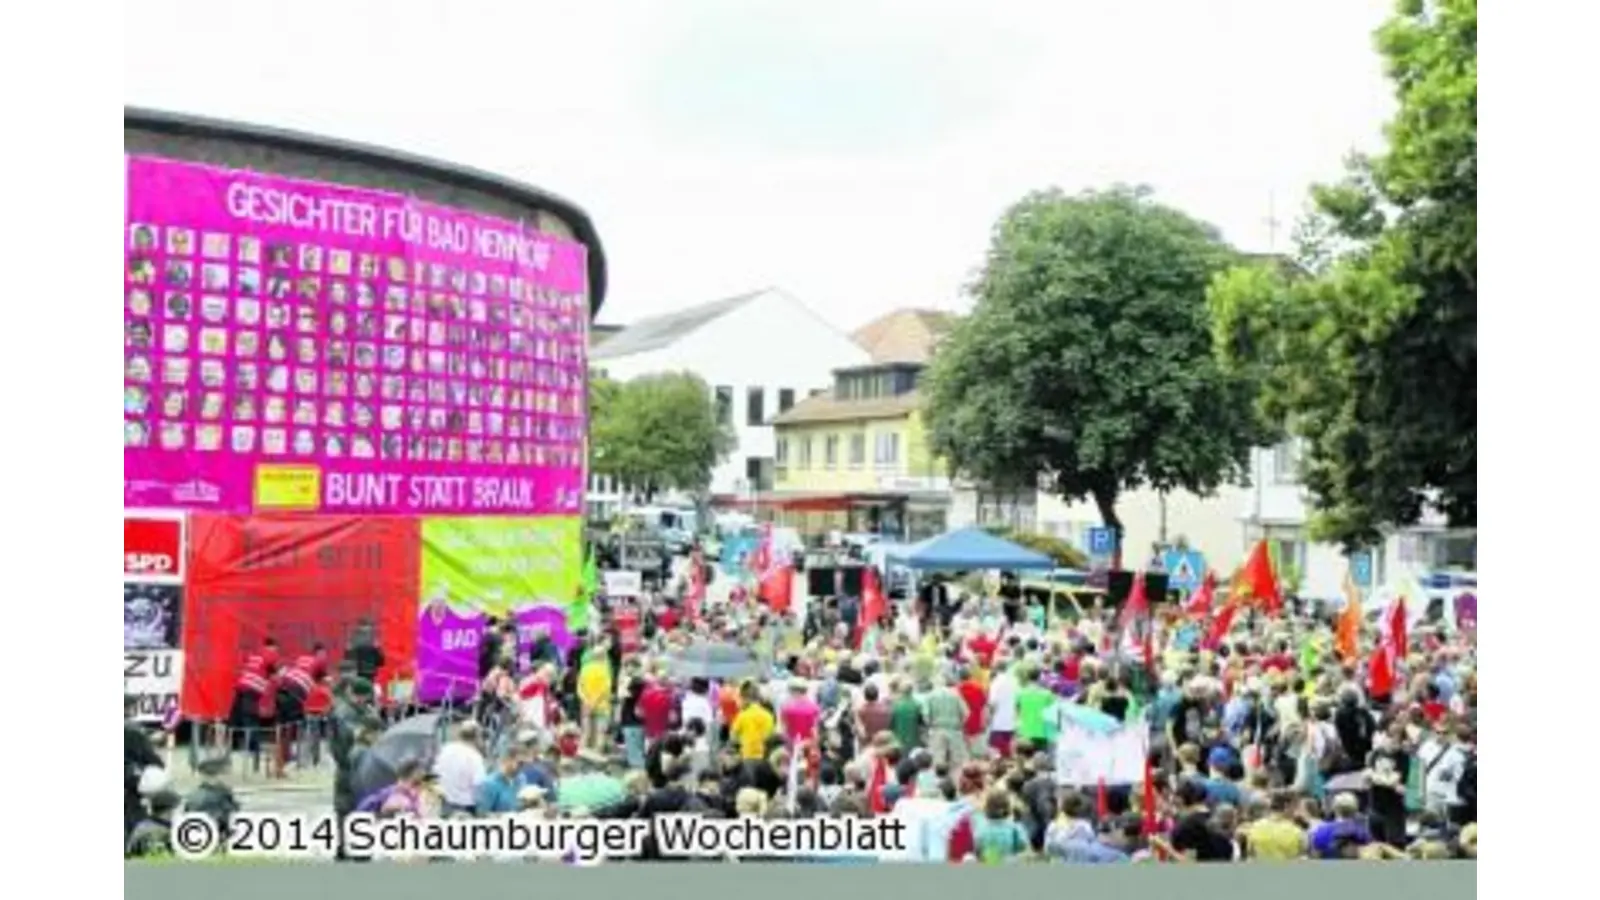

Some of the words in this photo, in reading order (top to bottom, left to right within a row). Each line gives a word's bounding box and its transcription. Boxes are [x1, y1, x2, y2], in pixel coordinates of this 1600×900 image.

[226, 181, 376, 239] GESICHTER
[427, 216, 470, 255] BAD
[326, 473, 402, 506] BUNT
[408, 475, 467, 508] STATT
[125, 552, 173, 571] SPD
[441, 628, 479, 650] BAD
